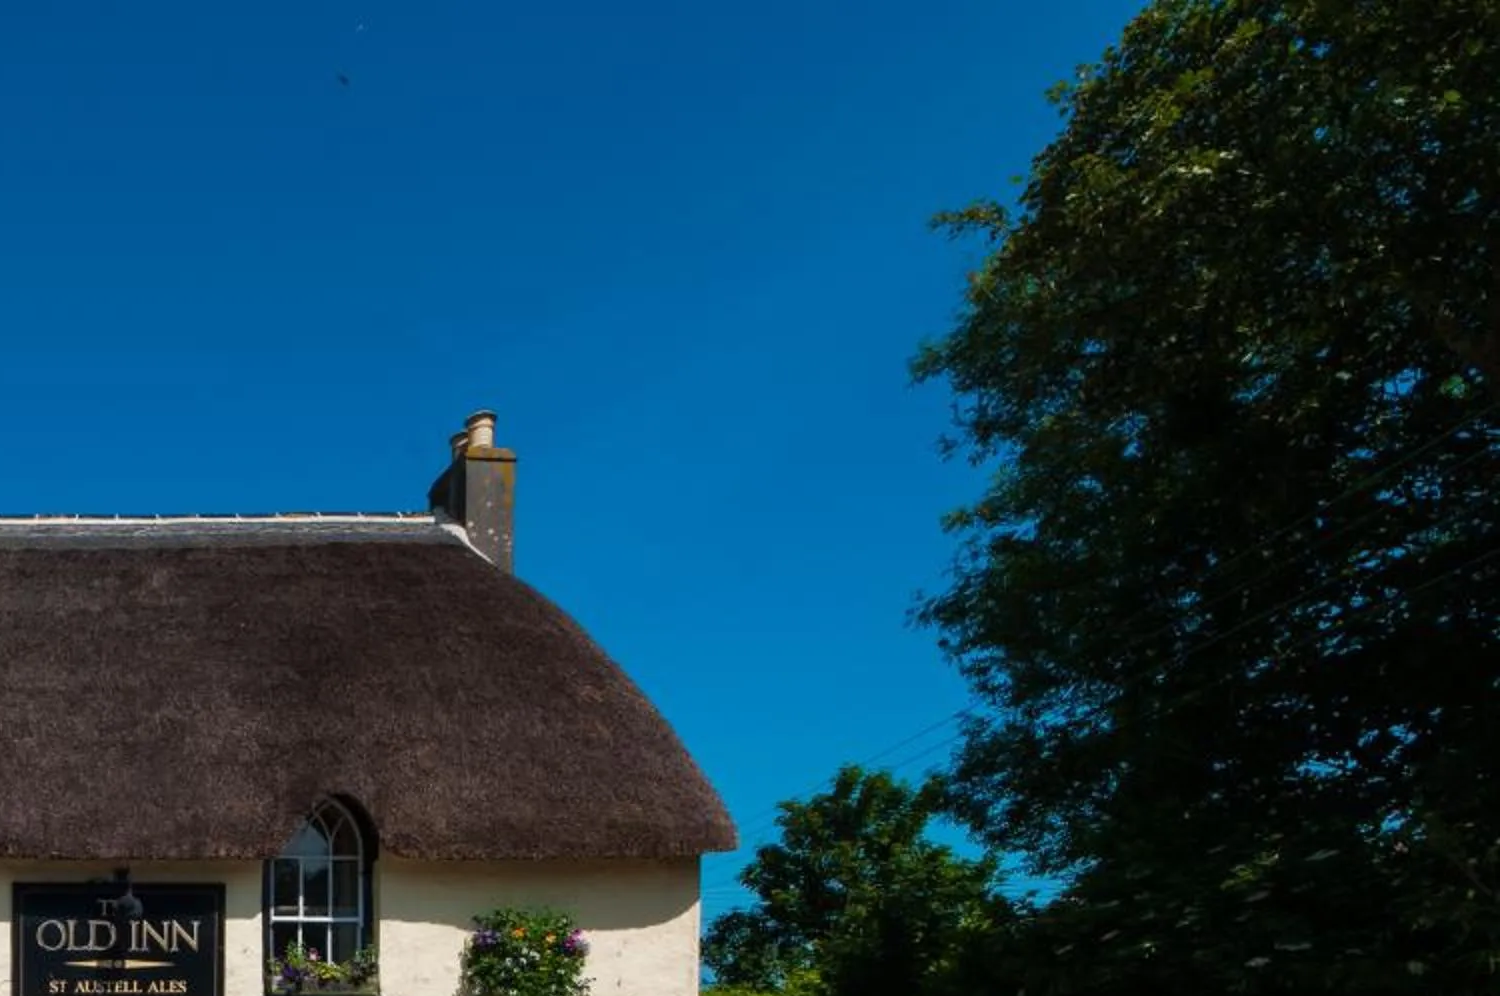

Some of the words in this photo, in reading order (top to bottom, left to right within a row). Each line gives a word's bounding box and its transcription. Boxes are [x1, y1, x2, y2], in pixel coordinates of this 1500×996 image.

[36, 919, 117, 951] OLD
[129, 919, 201, 953] INN
[49, 979, 68, 993] ST
[74, 979, 142, 993] AUSTELL
[147, 979, 188, 993] ALES
